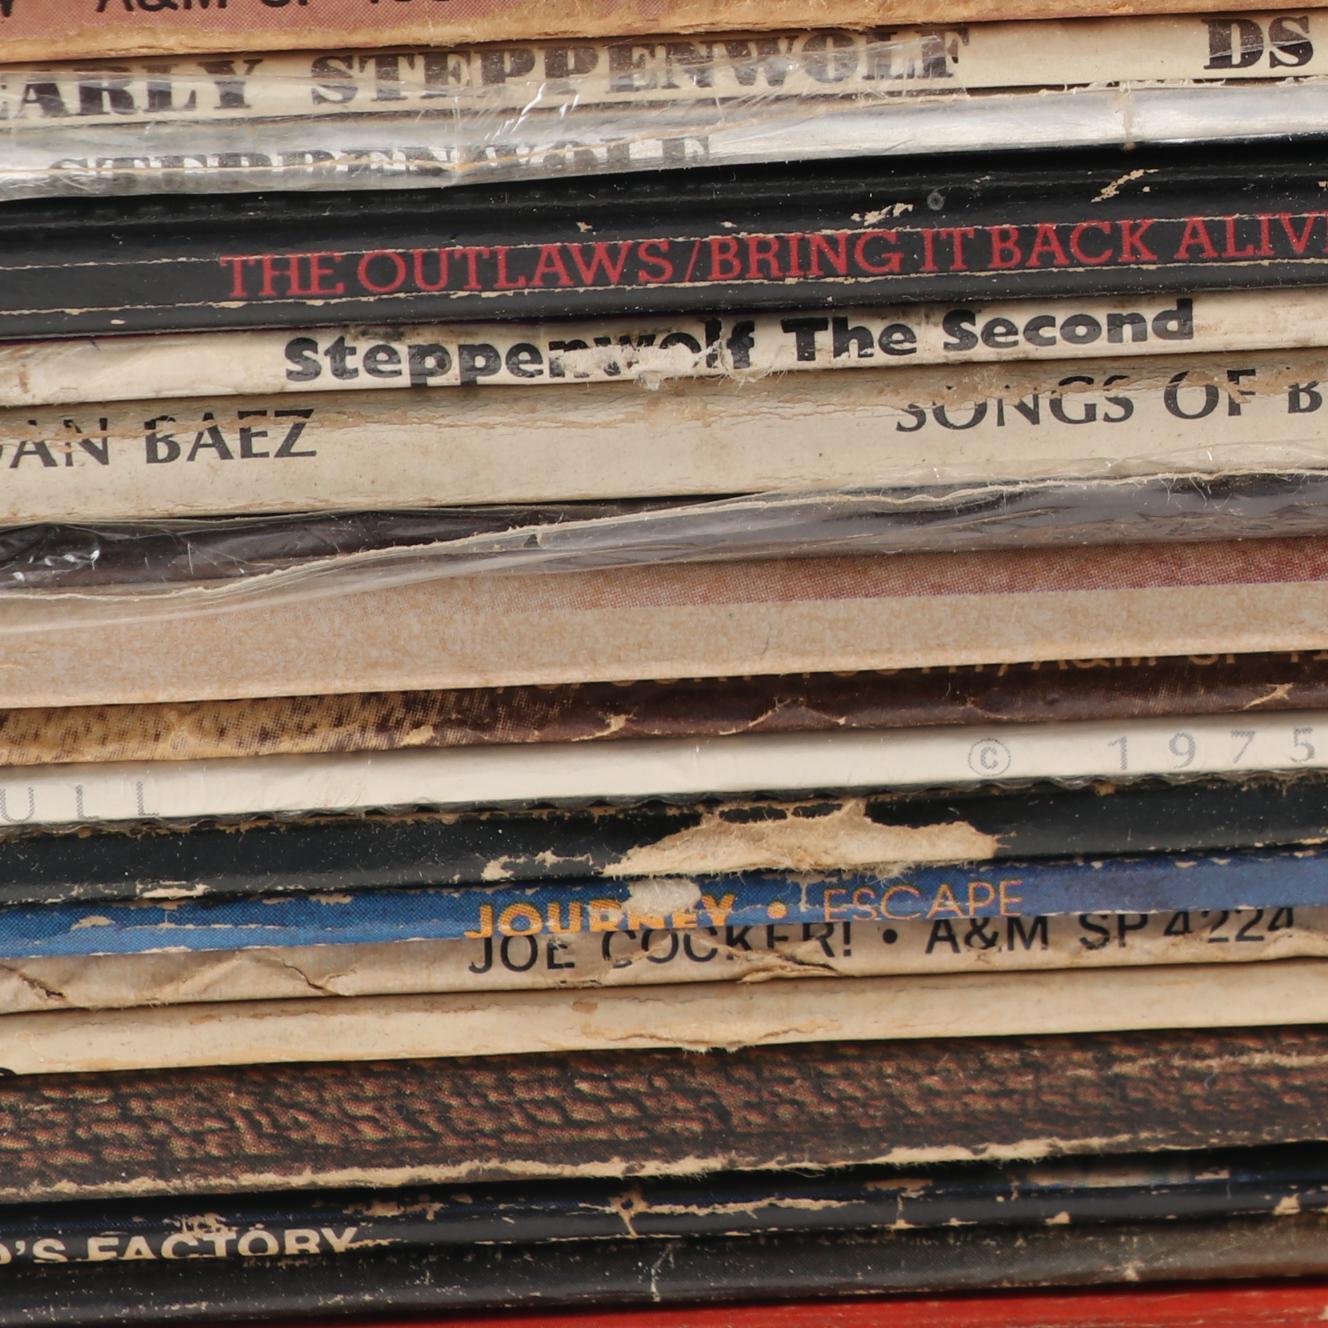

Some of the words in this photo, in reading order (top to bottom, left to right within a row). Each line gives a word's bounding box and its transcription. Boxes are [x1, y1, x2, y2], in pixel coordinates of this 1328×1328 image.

[0, 58, 263, 119] ARLY
[1203, 13, 1317, 71] DS
[220, 252, 346, 299] THE
[923, 225, 974, 272] IT
[990, 218, 1156, 270] BACK
[780, 313, 919, 362] The
[942, 299, 1195, 351] Second
[896, 375, 1135, 433] SONGS
[1164, 368, 1257, 421] OF
[0, 418, 110, 468] AN
[144, 408, 318, 464] BAEZ
[1108, 727, 1318, 770] 1975
[823, 880, 1024, 923] ESCAPE
[468, 934, 576, 974] JOE
[925, 916, 1049, 955] A&M
[1078, 913, 1149, 950] SP
[87, 1226, 358, 1261] FACTORY
